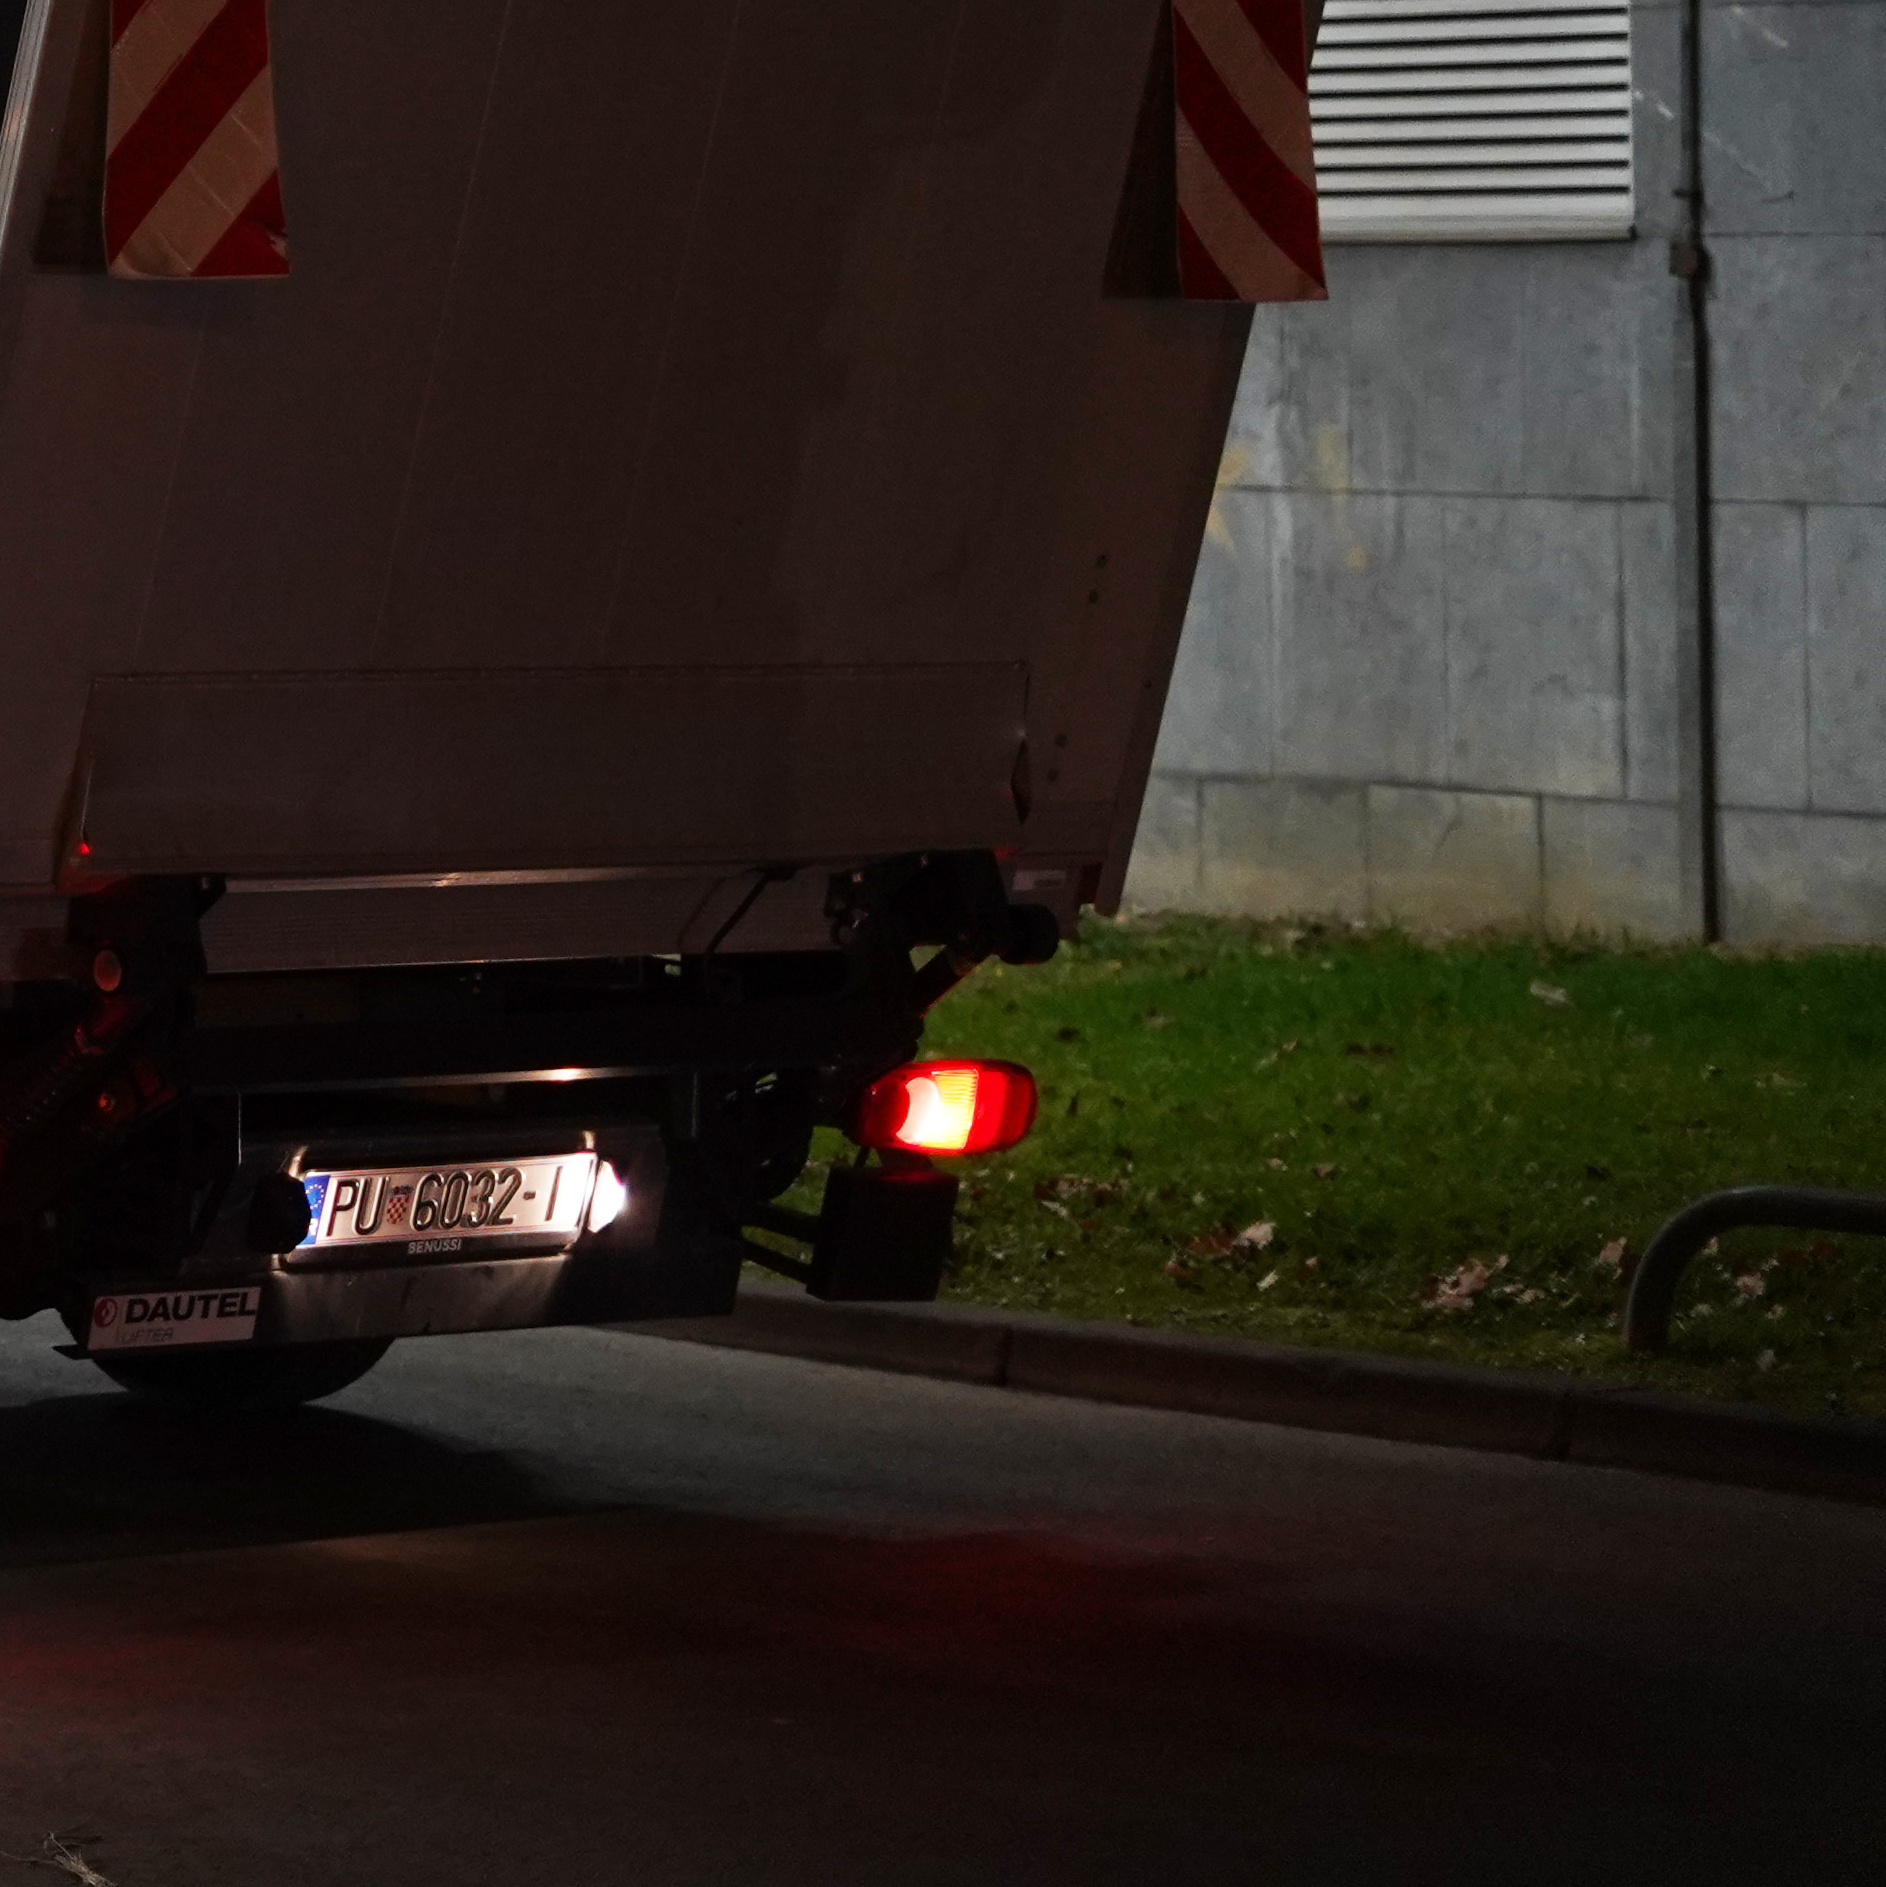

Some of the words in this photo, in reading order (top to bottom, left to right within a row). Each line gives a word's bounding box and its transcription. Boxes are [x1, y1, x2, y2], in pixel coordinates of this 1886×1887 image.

[325, 1176, 387, 1237] PU
[408, 1239, 462, 1254] BENUSSI
[125, 1292, 256, 1324] DAUTEL
